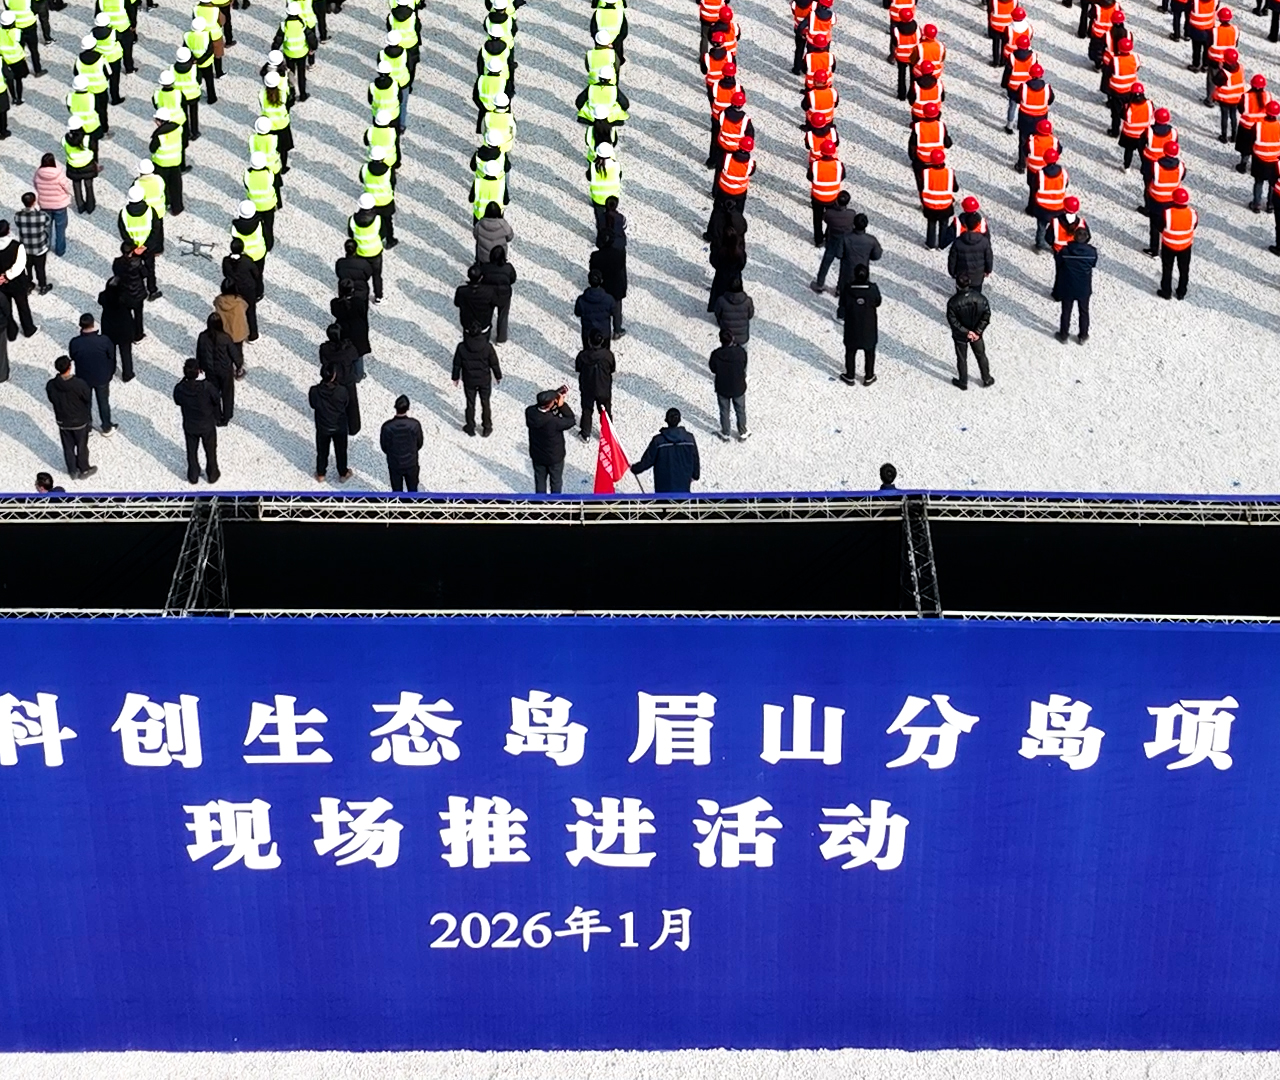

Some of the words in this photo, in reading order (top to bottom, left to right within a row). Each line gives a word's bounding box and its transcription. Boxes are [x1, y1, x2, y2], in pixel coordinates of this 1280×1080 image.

[183, 796, 910, 871] 现场推进活动
[431, 905, 692, 953] 2026年1月
